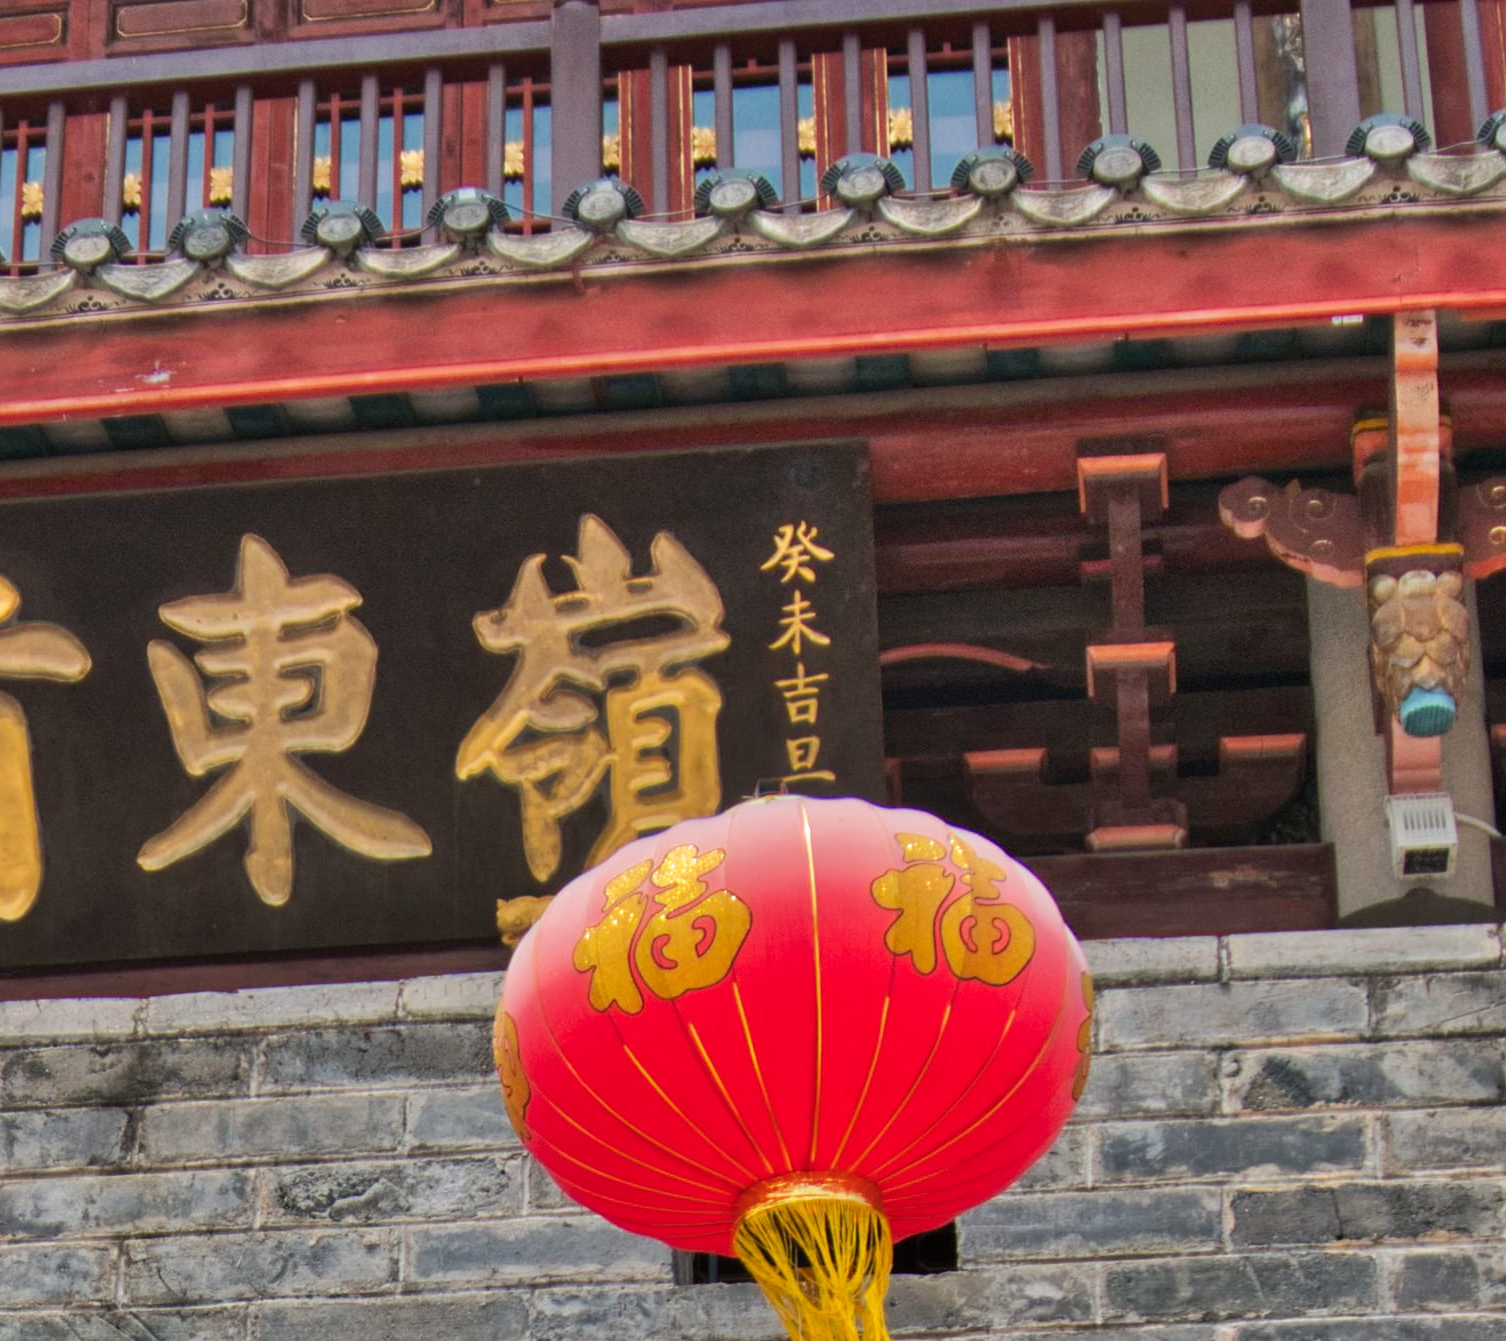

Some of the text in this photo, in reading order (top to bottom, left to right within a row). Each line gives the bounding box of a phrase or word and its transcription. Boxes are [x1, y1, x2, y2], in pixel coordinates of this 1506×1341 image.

[760, 519, 836, 783] 癸未吉旦
[573, 844, 752, 1016] 福
[871, 831, 1036, 986] 福
